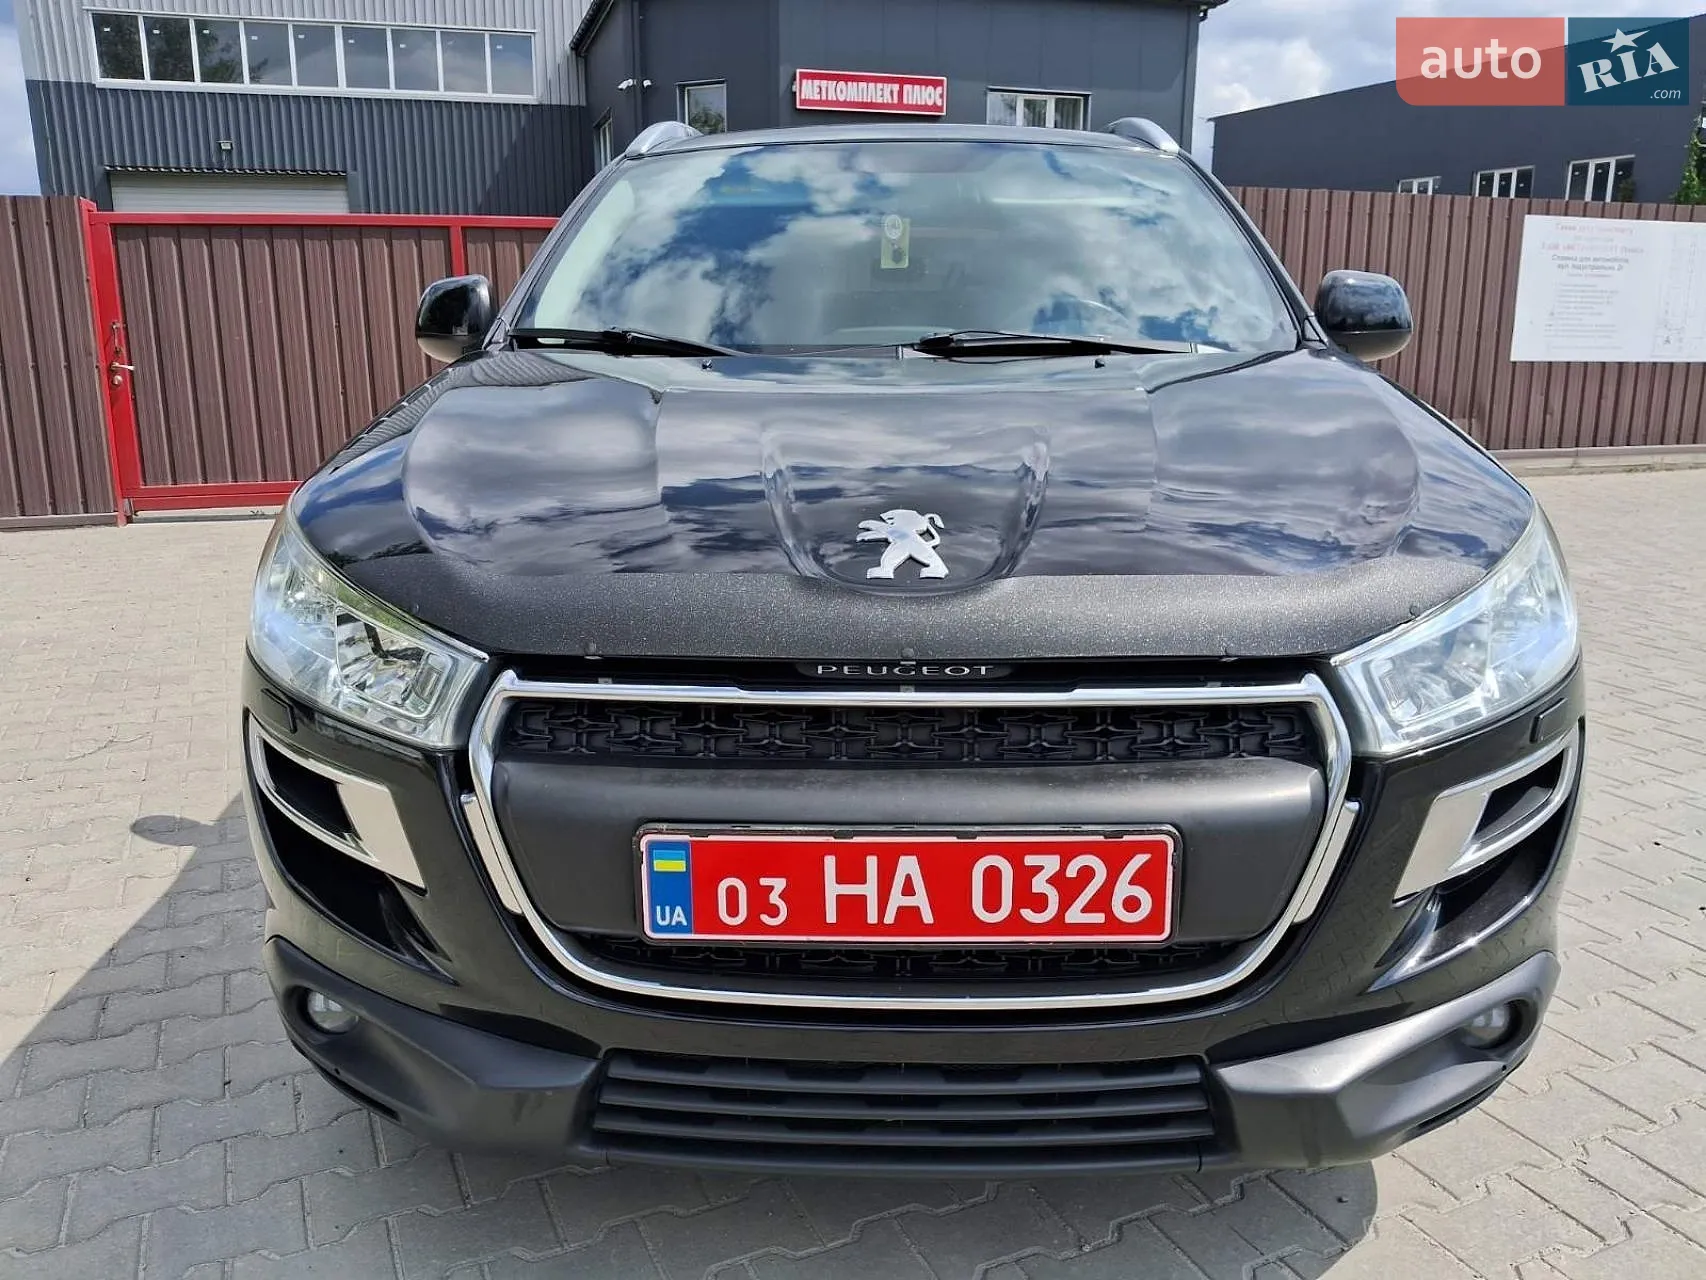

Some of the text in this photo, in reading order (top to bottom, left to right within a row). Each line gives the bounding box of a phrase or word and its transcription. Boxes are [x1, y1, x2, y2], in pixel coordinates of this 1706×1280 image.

[801, 79, 944, 106] МЕТКОМПЛЕКТ ПЛЮС
[816, 665, 994, 676] PEUGEOT
[717, 852, 1153, 926] 03 HA 0326
[656, 905, 688, 927] UA
